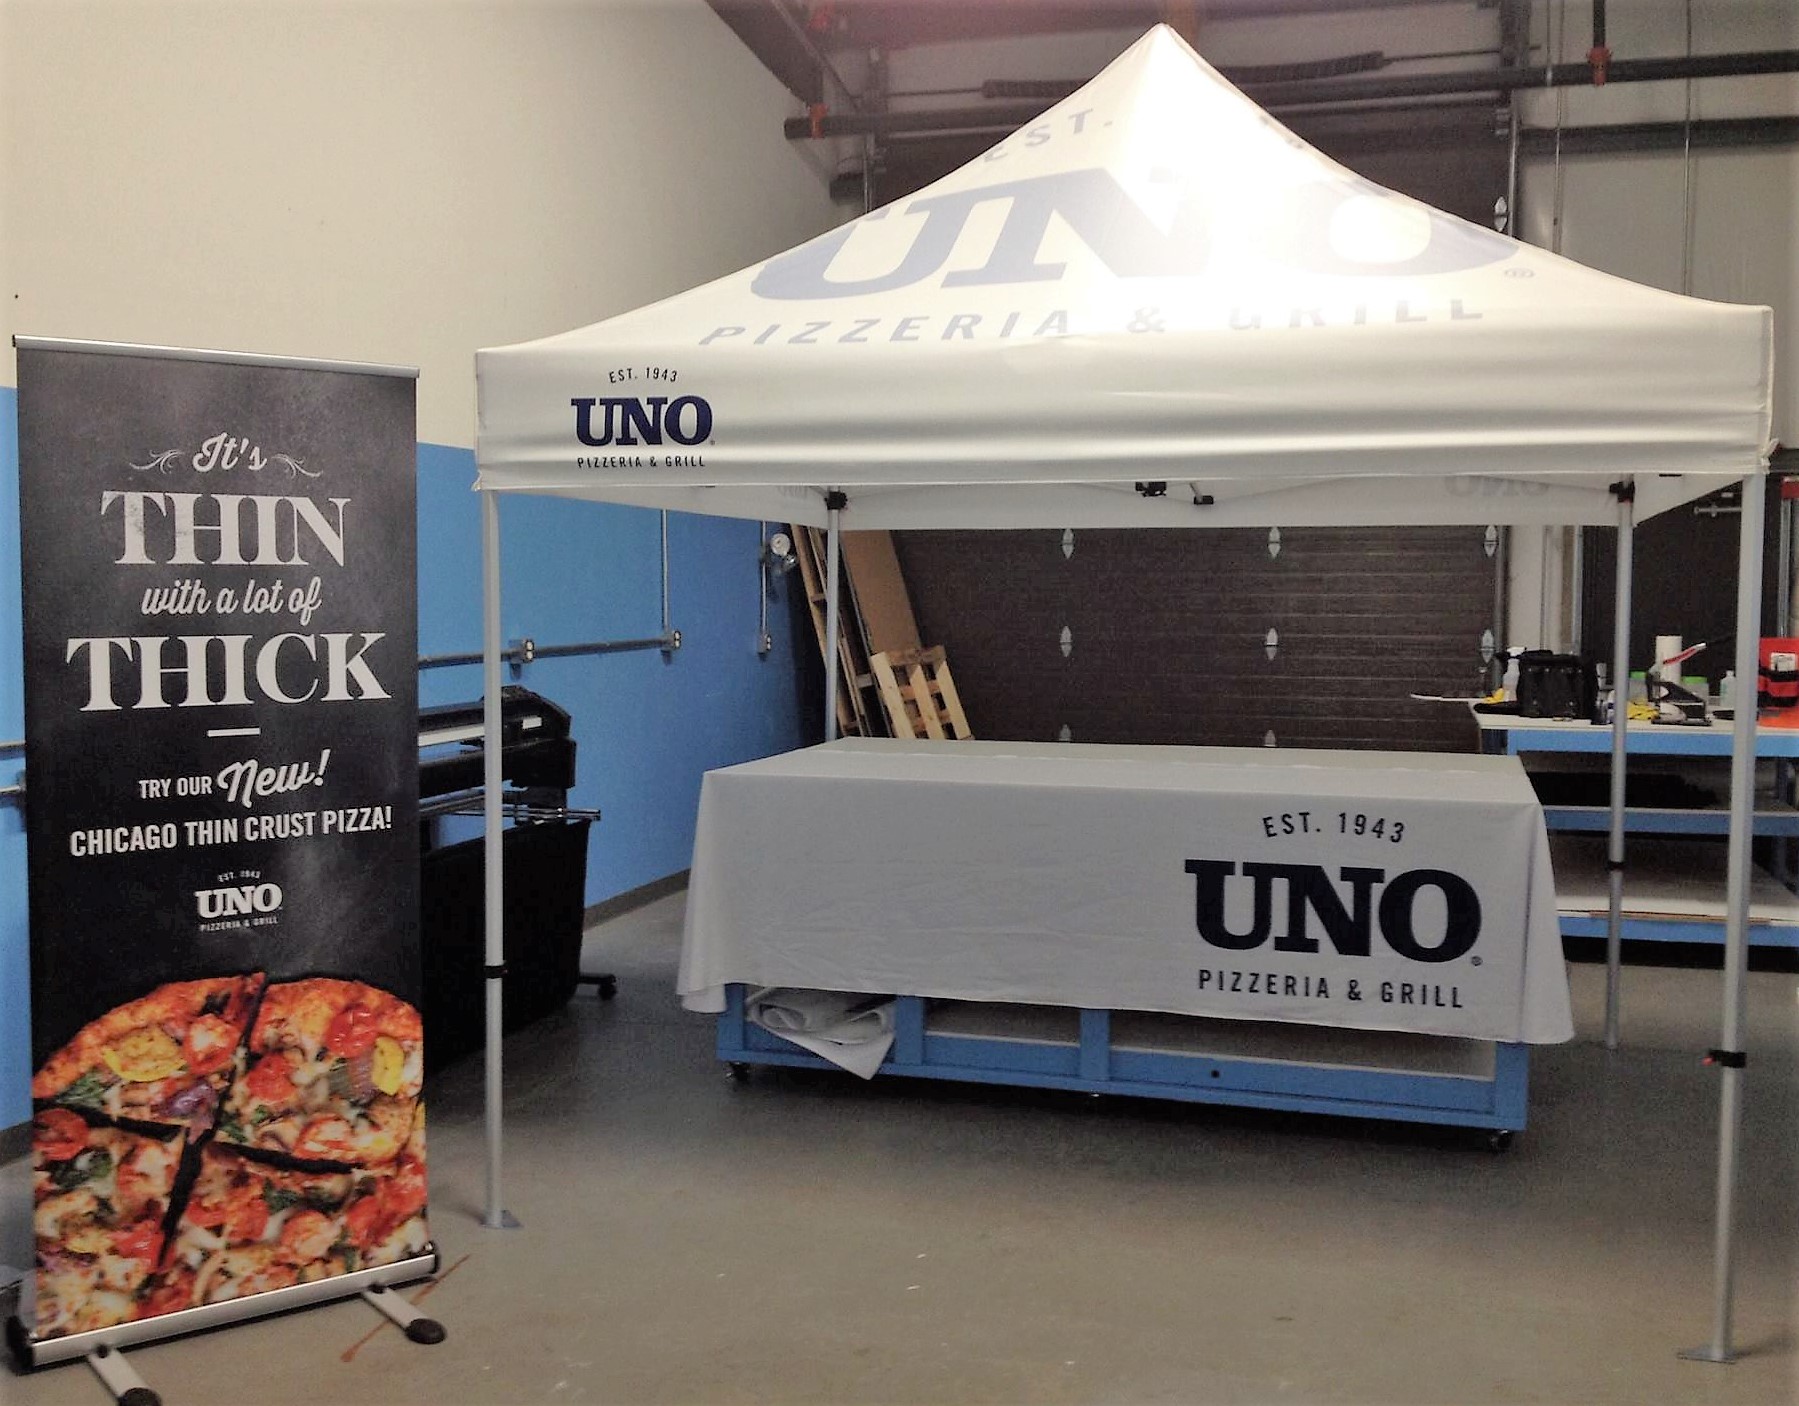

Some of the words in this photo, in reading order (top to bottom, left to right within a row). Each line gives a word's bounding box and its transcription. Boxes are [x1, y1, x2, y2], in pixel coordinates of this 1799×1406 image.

[699, 308, 1069, 346] PIZZERIA
[609, 368, 638, 383] EST.
[646, 367, 678, 382] 1943
[571, 395, 713, 446] UNO
[192, 432, 268, 472] It's
[578, 456, 642, 468] PIZZERIA
[650, 457, 657, 467] &
[665, 456, 705, 467] GRILL
[101, 490, 352, 567] THIN
[142, 580, 210, 615] with
[216, 588, 238, 614] a
[243, 580, 282, 613] lot
[288, 576, 322, 626] of
[66, 632, 392, 712] THICK
[139, 778, 171, 799] TRY
[177, 775, 212, 796] OUR
[218, 748, 331, 808] New!
[69, 822, 178, 857] CHICAGO
[185, 818, 239, 846] THIN
[244, 812, 315, 842] CRUST
[322, 805, 393, 834] PIZZA!
[1262, 812, 1322, 838] EST.
[1339, 812, 1404, 843] 1943
[194, 882, 283, 918] UNO
[1184, 858, 1482, 963] UNO
[1199, 969, 1329, 999] PIZZERIA
[1347, 979, 1362, 1001] &
[1381, 981, 1464, 1009] GRILL
